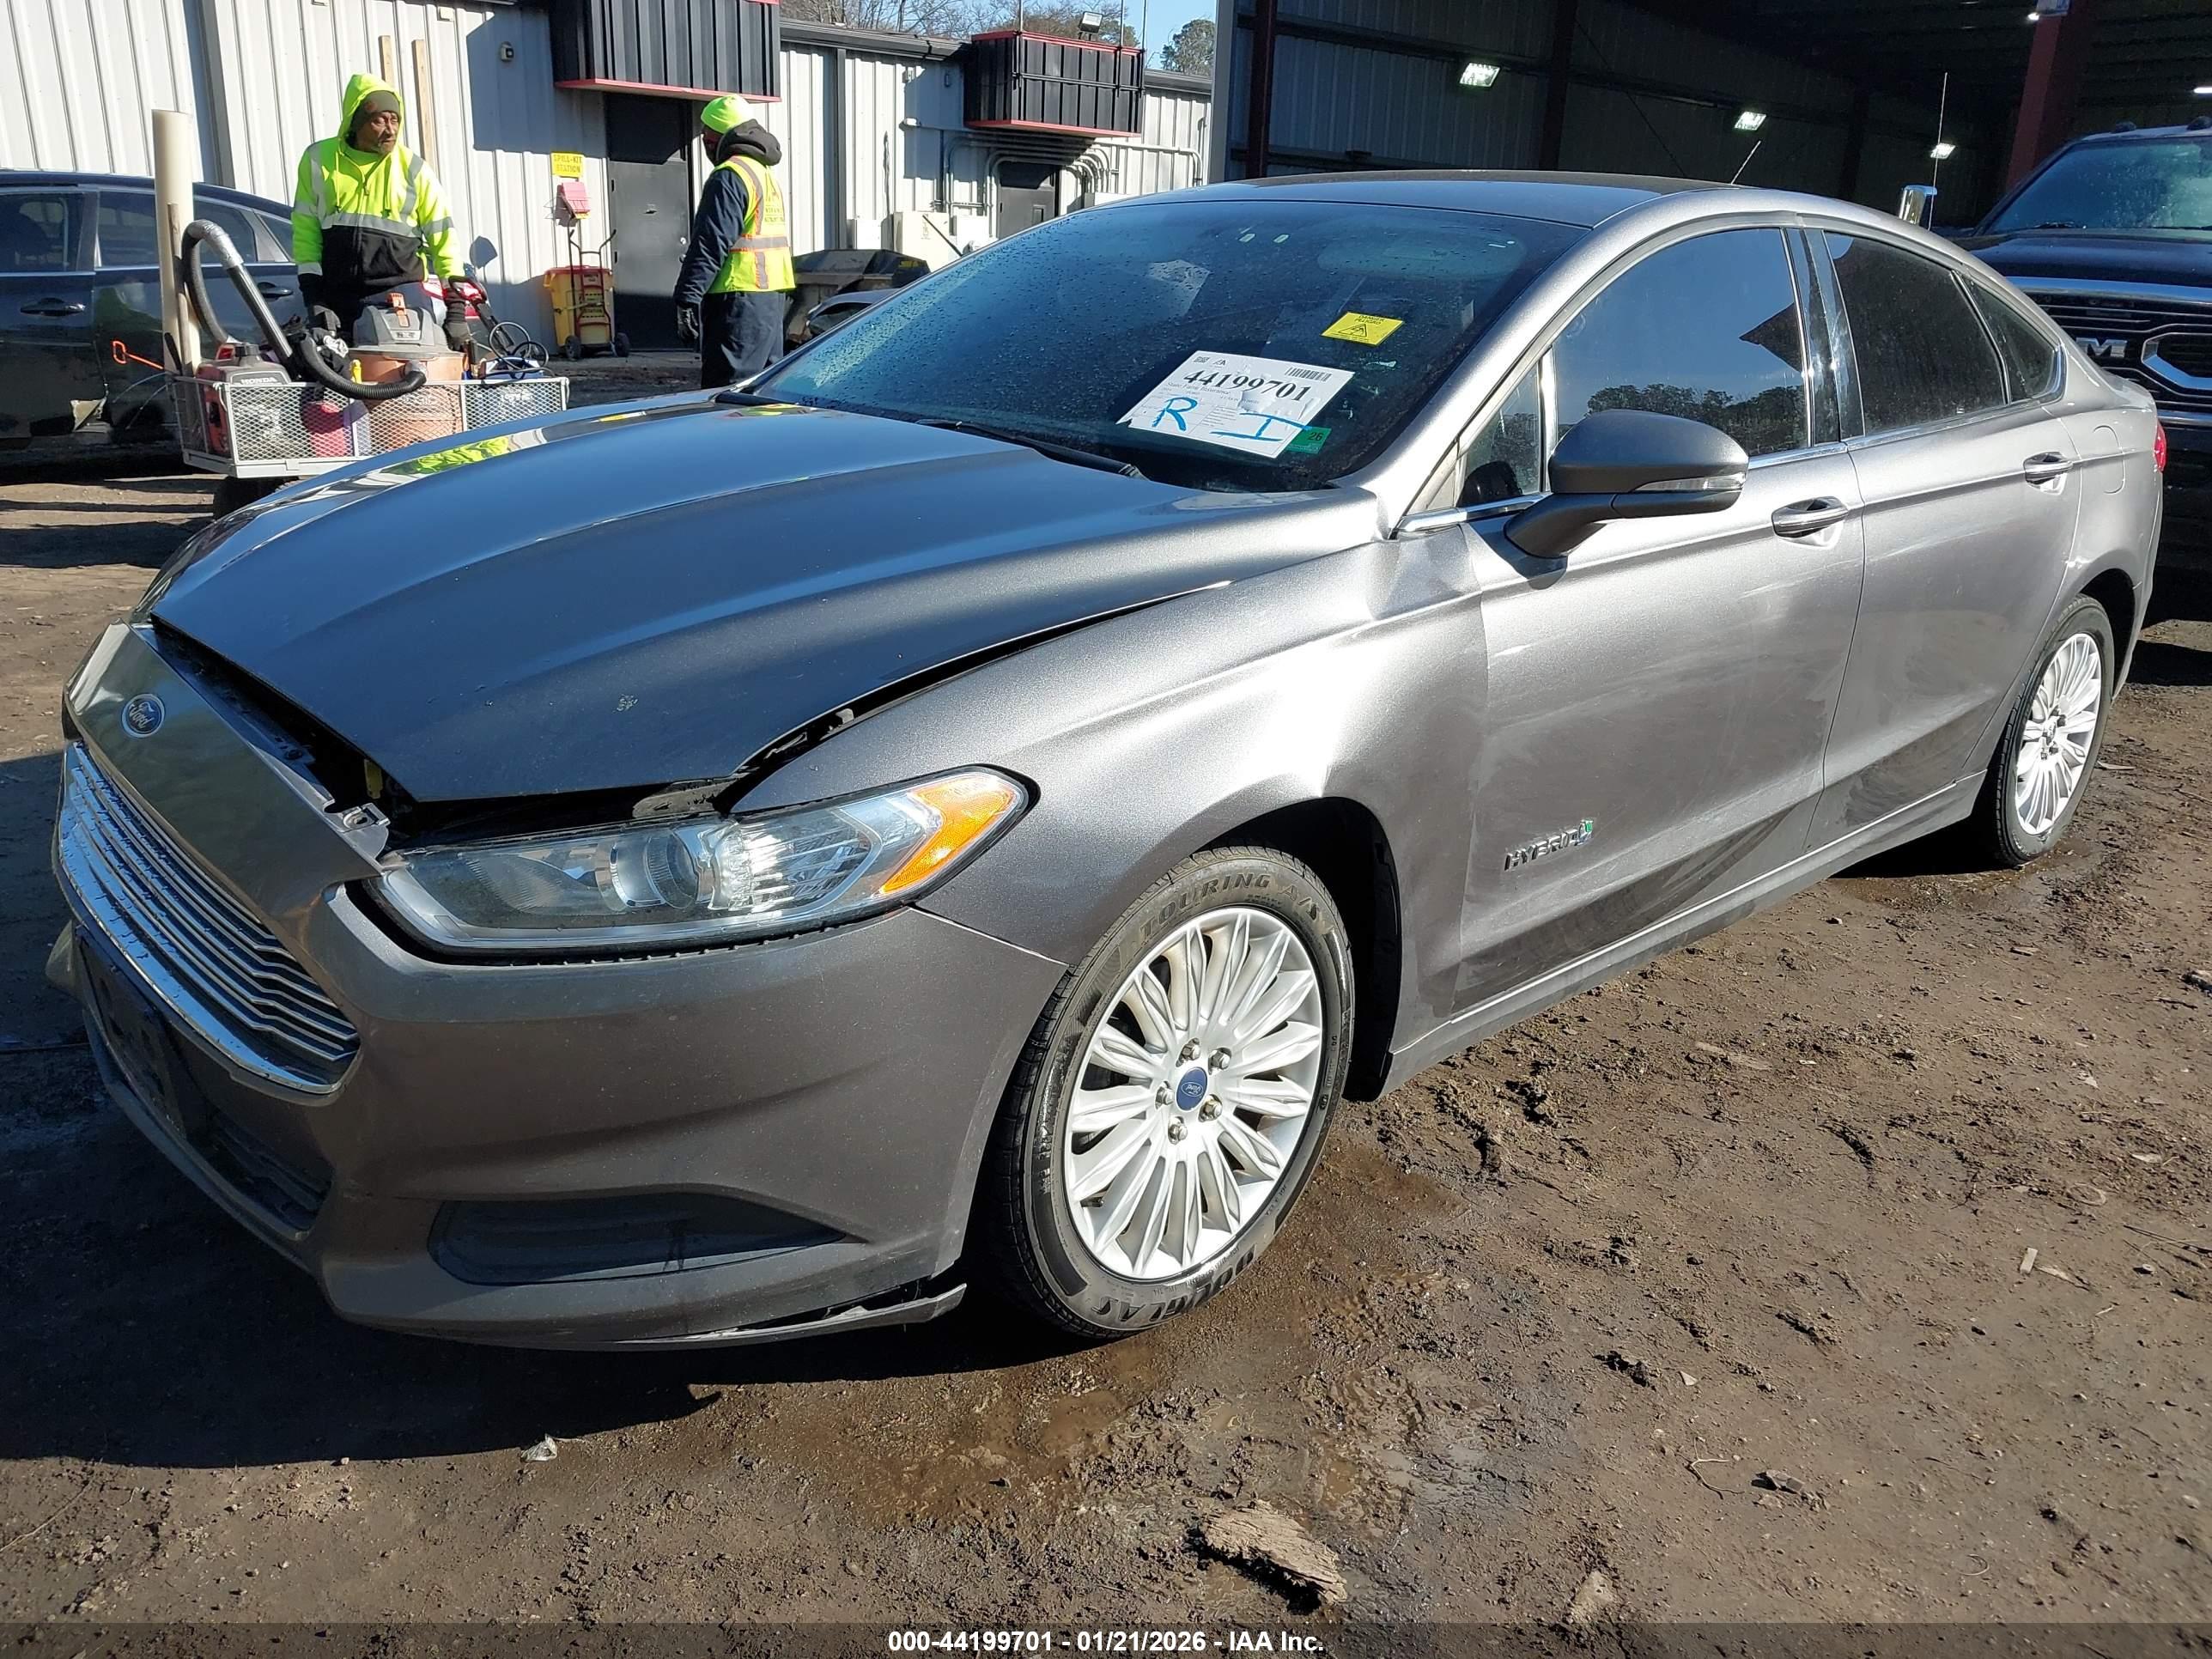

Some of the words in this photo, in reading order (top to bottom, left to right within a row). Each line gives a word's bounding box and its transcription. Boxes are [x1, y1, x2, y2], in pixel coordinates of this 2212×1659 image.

[553, 154, 582, 163] SPILL-KIT
[556, 163, 581, 173] STATION
[240, 376, 277, 385] HONDA
[1182, 369, 1312, 402] 44199701
[1151, 396, 1199, 432] R
[1306, 431, 1324, 441] 26
[1139, 872, 1272, 939] TOURING
